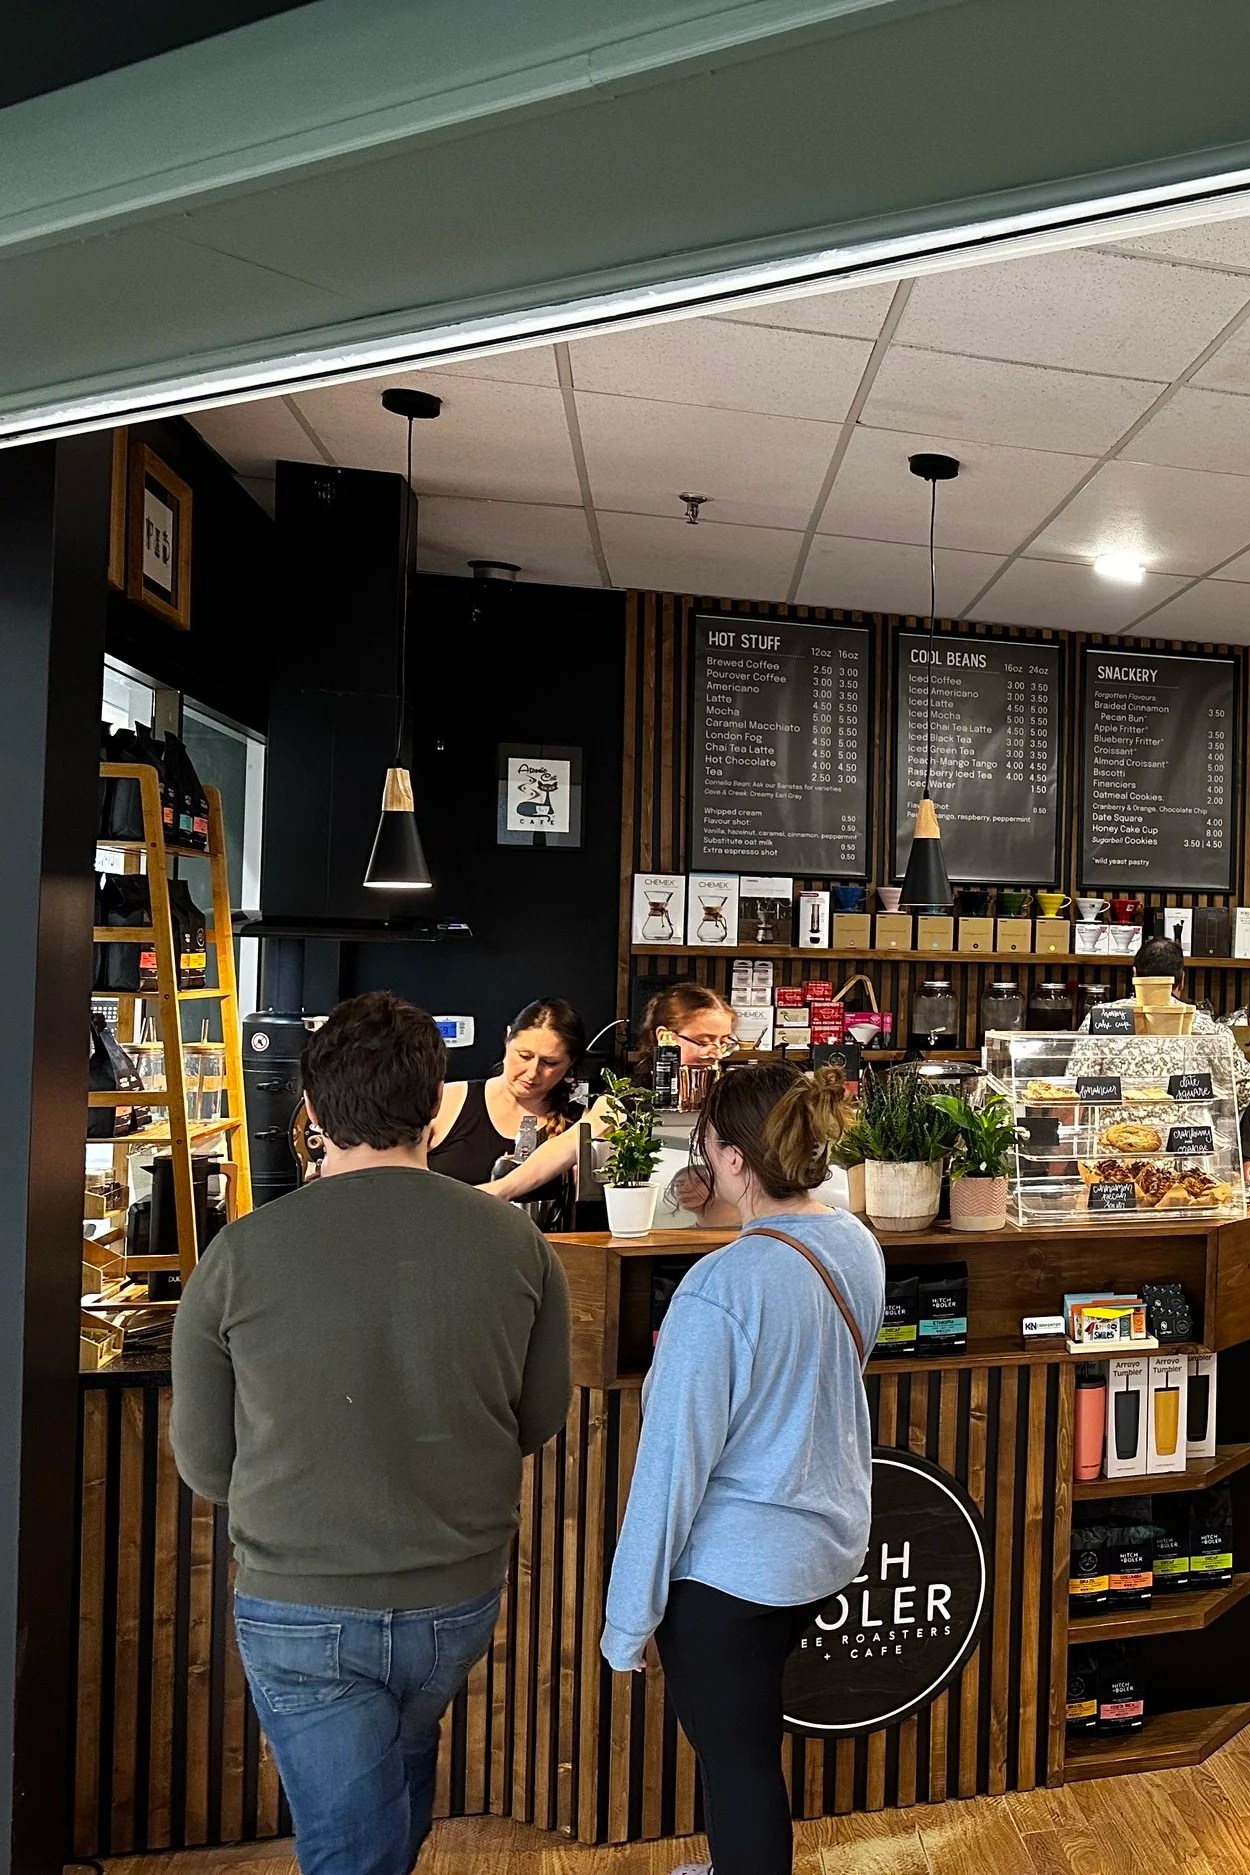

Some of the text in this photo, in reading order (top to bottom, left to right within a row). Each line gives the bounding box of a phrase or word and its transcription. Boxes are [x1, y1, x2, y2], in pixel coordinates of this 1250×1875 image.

[709, 631, 859, 660] HOT STUFF 12oz 16oz
[707, 657, 858, 677] Brewed Coffee 3.00
[911, 649, 1048, 675] COOL BEANS 16oz 24oz
[707, 669, 786, 683] Pourover Coffee
[1098, 666, 1158, 682] SNACKERY
[909, 674, 1024, 689] Iced Coffee 3.00
[707, 682, 858, 700] Americano 3.00 3.50
[909, 686, 1024, 701] Iced Americano 3.00
[1094, 691, 1127, 700] Forgotten
[706, 694, 832, 711] Latte 4.50
[909, 698, 953, 708] Iced Latte
[1094, 701, 1169, 713] Braided Cinnamon
[706, 706, 832, 722] Mocha 5.00
[908, 709, 960, 720] Iced Mocha
[1101, 714, 1126, 722] Pecan
[706, 718, 831, 735] Caramel Macchiato 5.00
[908, 721, 992, 733] Iced Chai Tea Latte
[1094, 724, 1118, 733] Apple
[706, 730, 857, 748] London Fog 5.00
[908, 733, 928, 741] Iced
[930, 734, 954, 742] Black
[1094, 735, 1133, 746] Blueberry
[705, 743, 774, 754] Chai Tea Latte
[908, 744, 975, 755] Iced Green Tea
[705, 755, 831, 770] Hot Chocolate 4.00
[972, 760, 997, 768] Tango
[1094, 758, 1124, 766] Almond
[705, 767, 857, 783] Tea 3.00
[955, 770, 974, 778] Iced
[977, 771, 992, 779] Tea
[1094, 769, 1125, 777] Biscotti
[929, 780, 1046, 793] Water 1.50
[1094, 780, 1136, 789] Financiers
[1093, 791, 1128, 800] Oatmeal
[704, 808, 737, 816] Whipped
[1093, 803, 1125, 811] Cranberry
[1159, 806, 1192, 814] Chocolate
[704, 817, 730, 825] Flavour
[1093, 813, 1143, 823] Date Square
[1093, 825, 1158, 835] Honey Cake Cup
[703, 837, 742, 845] Substitute
[1125, 837, 1157, 845] Cookies
[724, 848, 759, 856] espresso
[1025, 1322, 1037, 1330] KN
[1113, 1369, 1142, 1377] Tumbler
[815, 1584, 952, 1631] OLER
[842, 1625, 951, 1644] ROASTERS
[850, 1645, 902, 1659] CAFE
